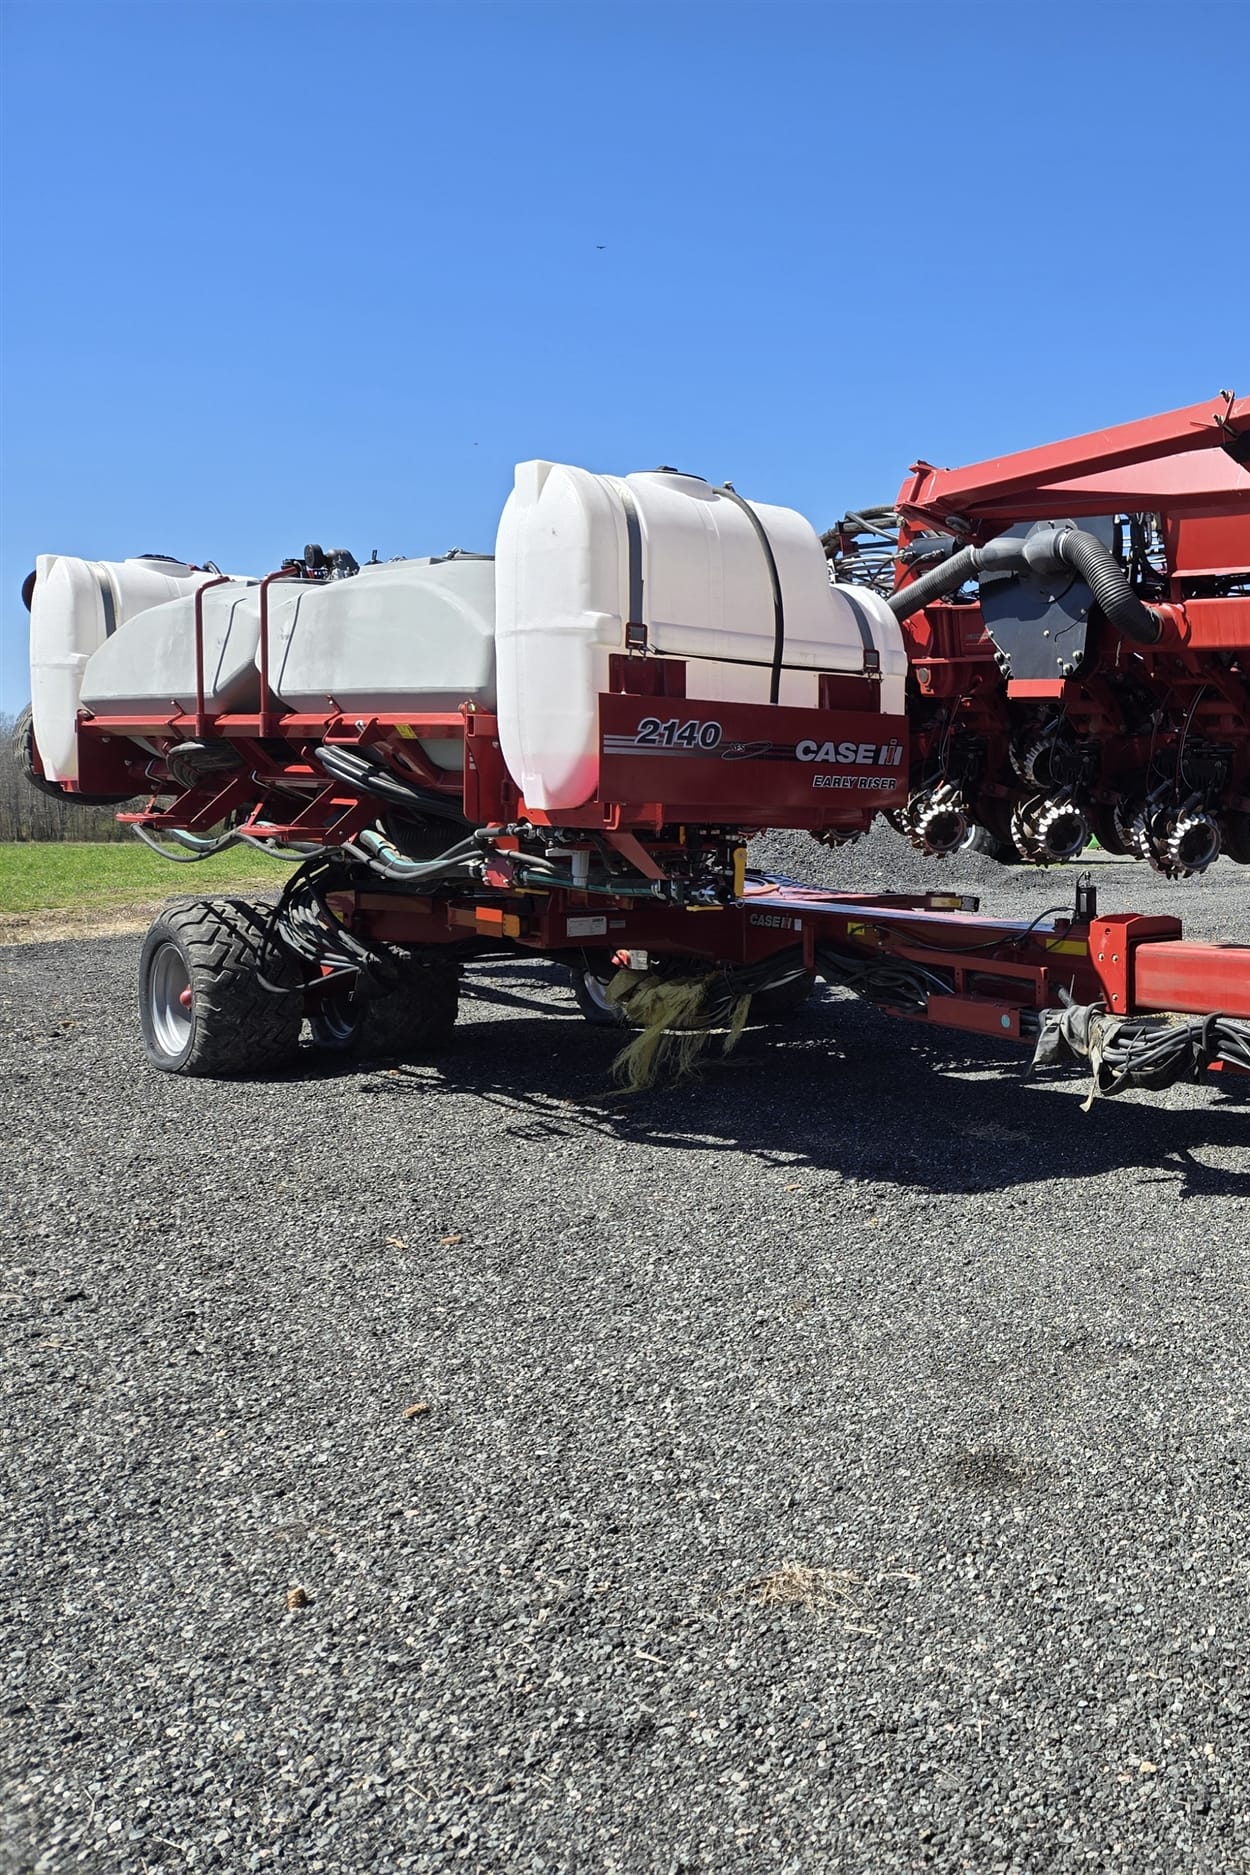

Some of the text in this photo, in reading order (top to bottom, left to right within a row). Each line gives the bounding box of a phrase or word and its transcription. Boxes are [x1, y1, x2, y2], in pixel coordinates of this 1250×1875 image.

[634, 717, 722, 750] 2140
[795, 739, 876, 765] CASE
[813, 774, 897, 790] EARLY RISER
[750, 913, 781, 928] CASE
